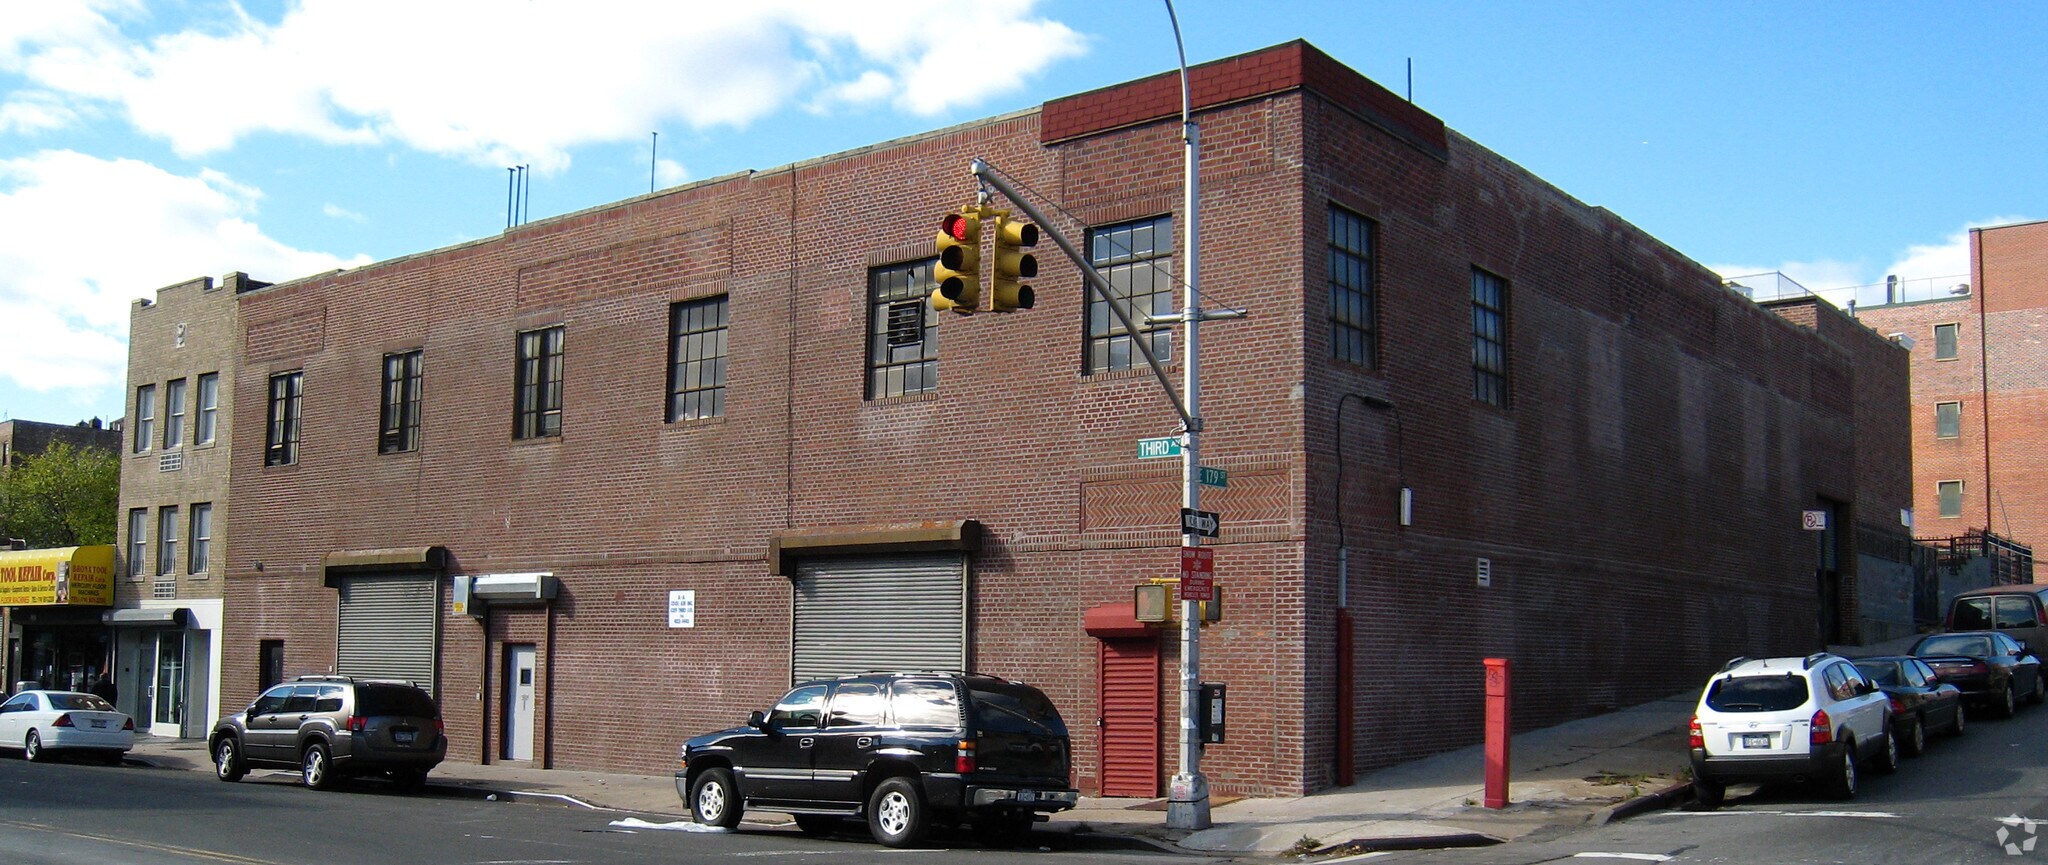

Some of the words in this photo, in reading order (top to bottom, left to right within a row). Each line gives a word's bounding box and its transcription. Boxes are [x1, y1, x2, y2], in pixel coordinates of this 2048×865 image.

[1140, 440, 1170, 457] THIRD
[1206, 469, 1219, 484] 179
[1201, 518, 1214, 529] WAY
[1, 567, 16, 582] TOOL
[18, 565, 42, 582] REPAIR
[93, 566, 107, 574] TOOL
[73, 573, 95, 582] REPAIR
